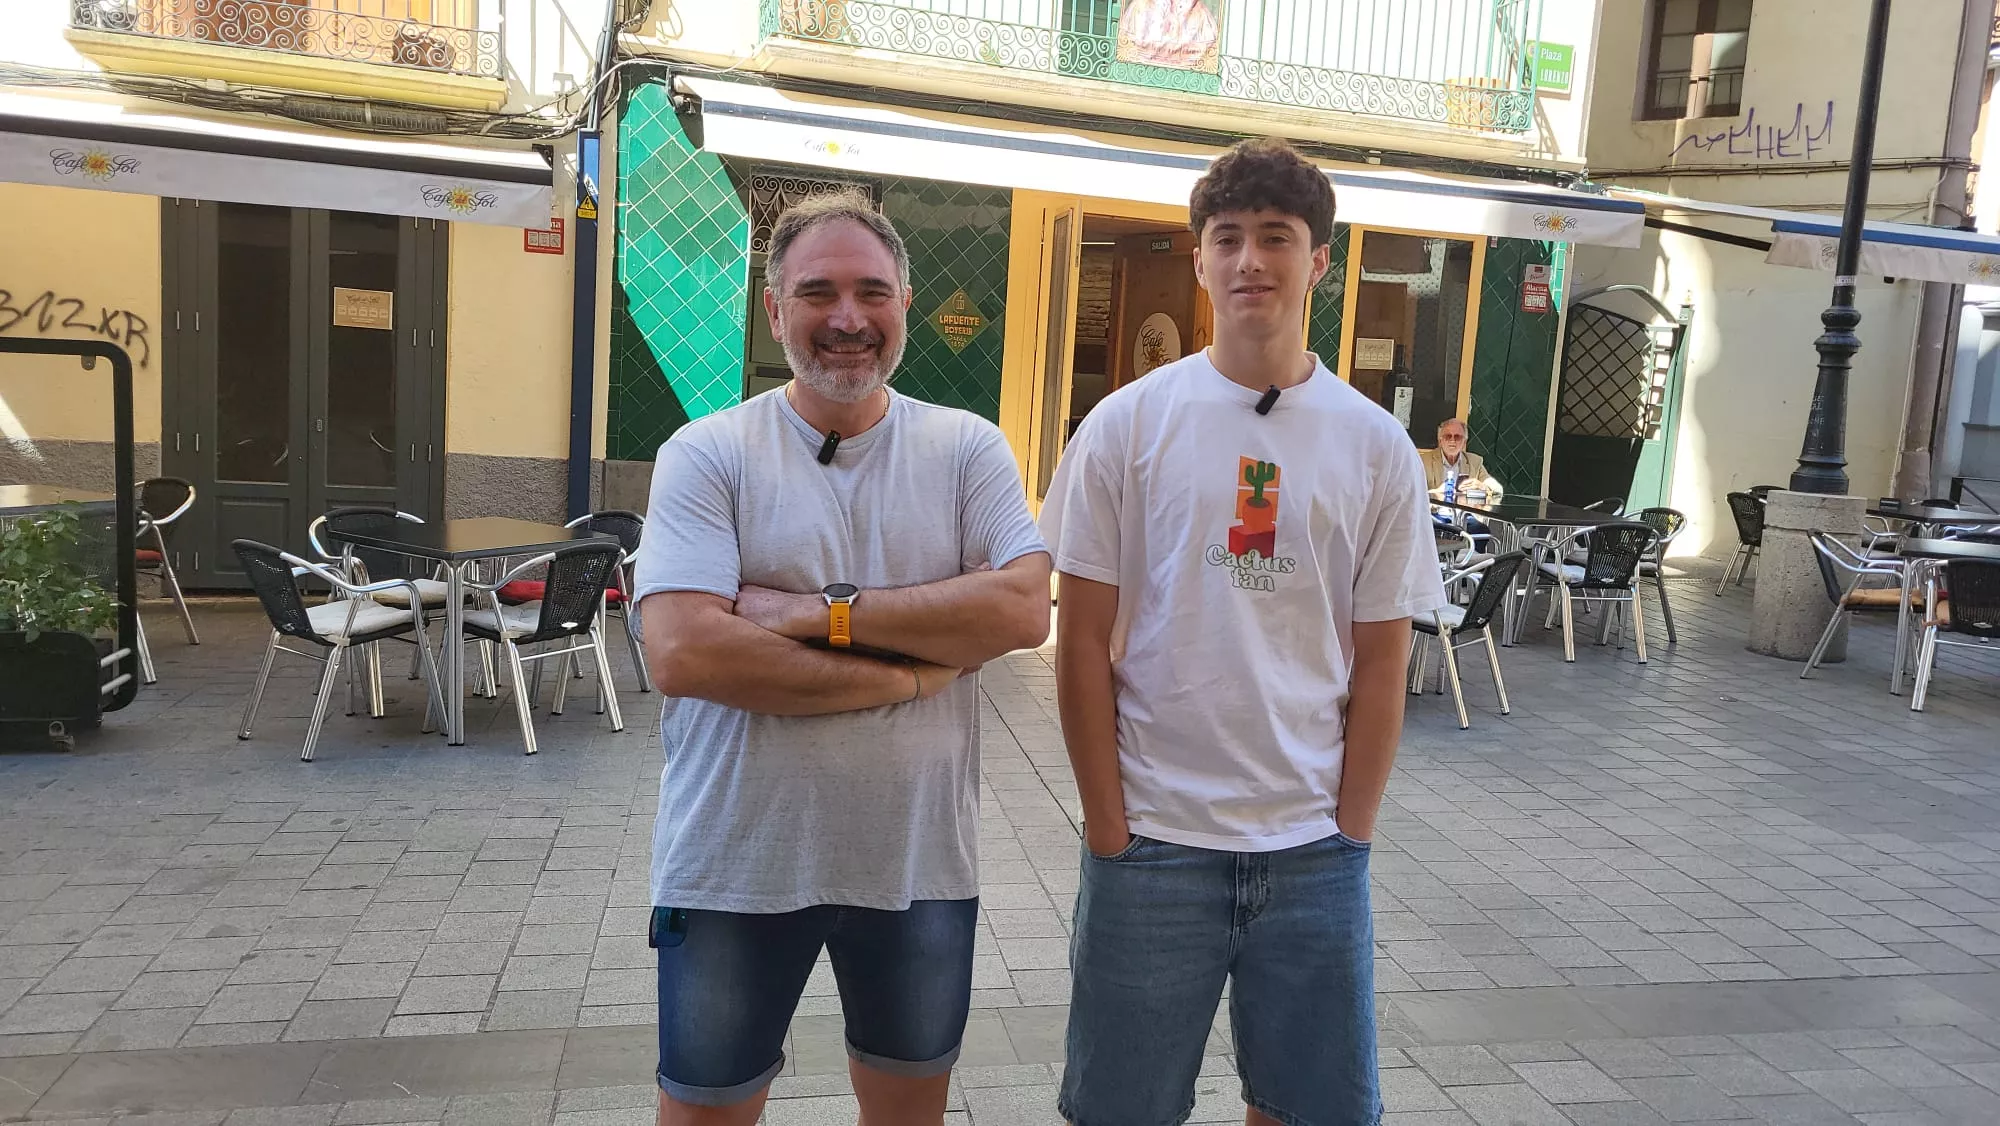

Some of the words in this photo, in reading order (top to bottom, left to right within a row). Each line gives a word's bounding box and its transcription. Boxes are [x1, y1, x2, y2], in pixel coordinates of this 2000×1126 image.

[1540, 47, 1562, 61] Plaza
[106, 154, 141, 180] Sol
[468, 190, 498, 212] Sol
[1151, 240, 1170, 250] SALIDA
[939, 315, 980, 326] LAFUENTE
[1206, 544, 1296, 573] Cactus
[1231, 567, 1275, 592] fan
